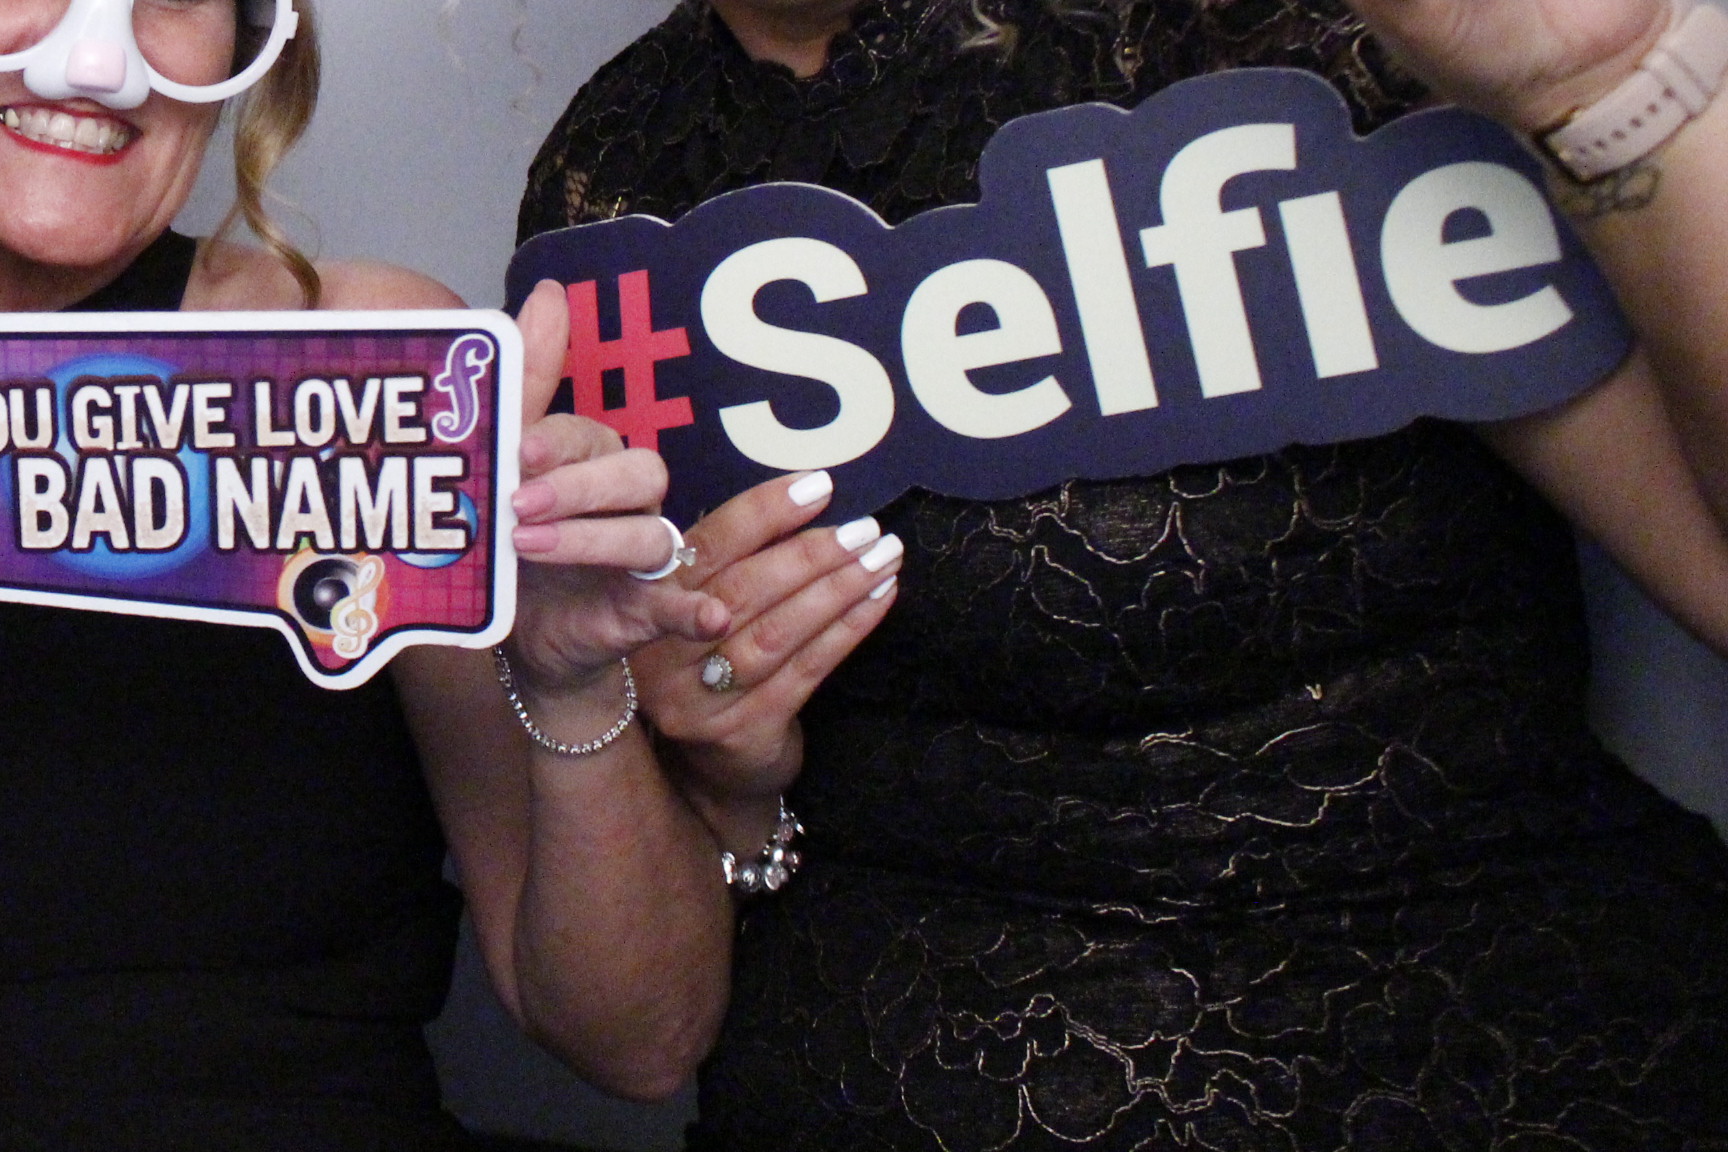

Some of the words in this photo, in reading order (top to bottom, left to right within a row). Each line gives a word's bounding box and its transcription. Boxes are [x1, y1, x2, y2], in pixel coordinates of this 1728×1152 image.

[562, 122, 1573, 471] #Selfie
[74, 382, 235, 449] GIVE
[255, 378, 427, 446] LOVE
[17, 456, 184, 549] BAD
[215, 456, 466, 551] NAME
